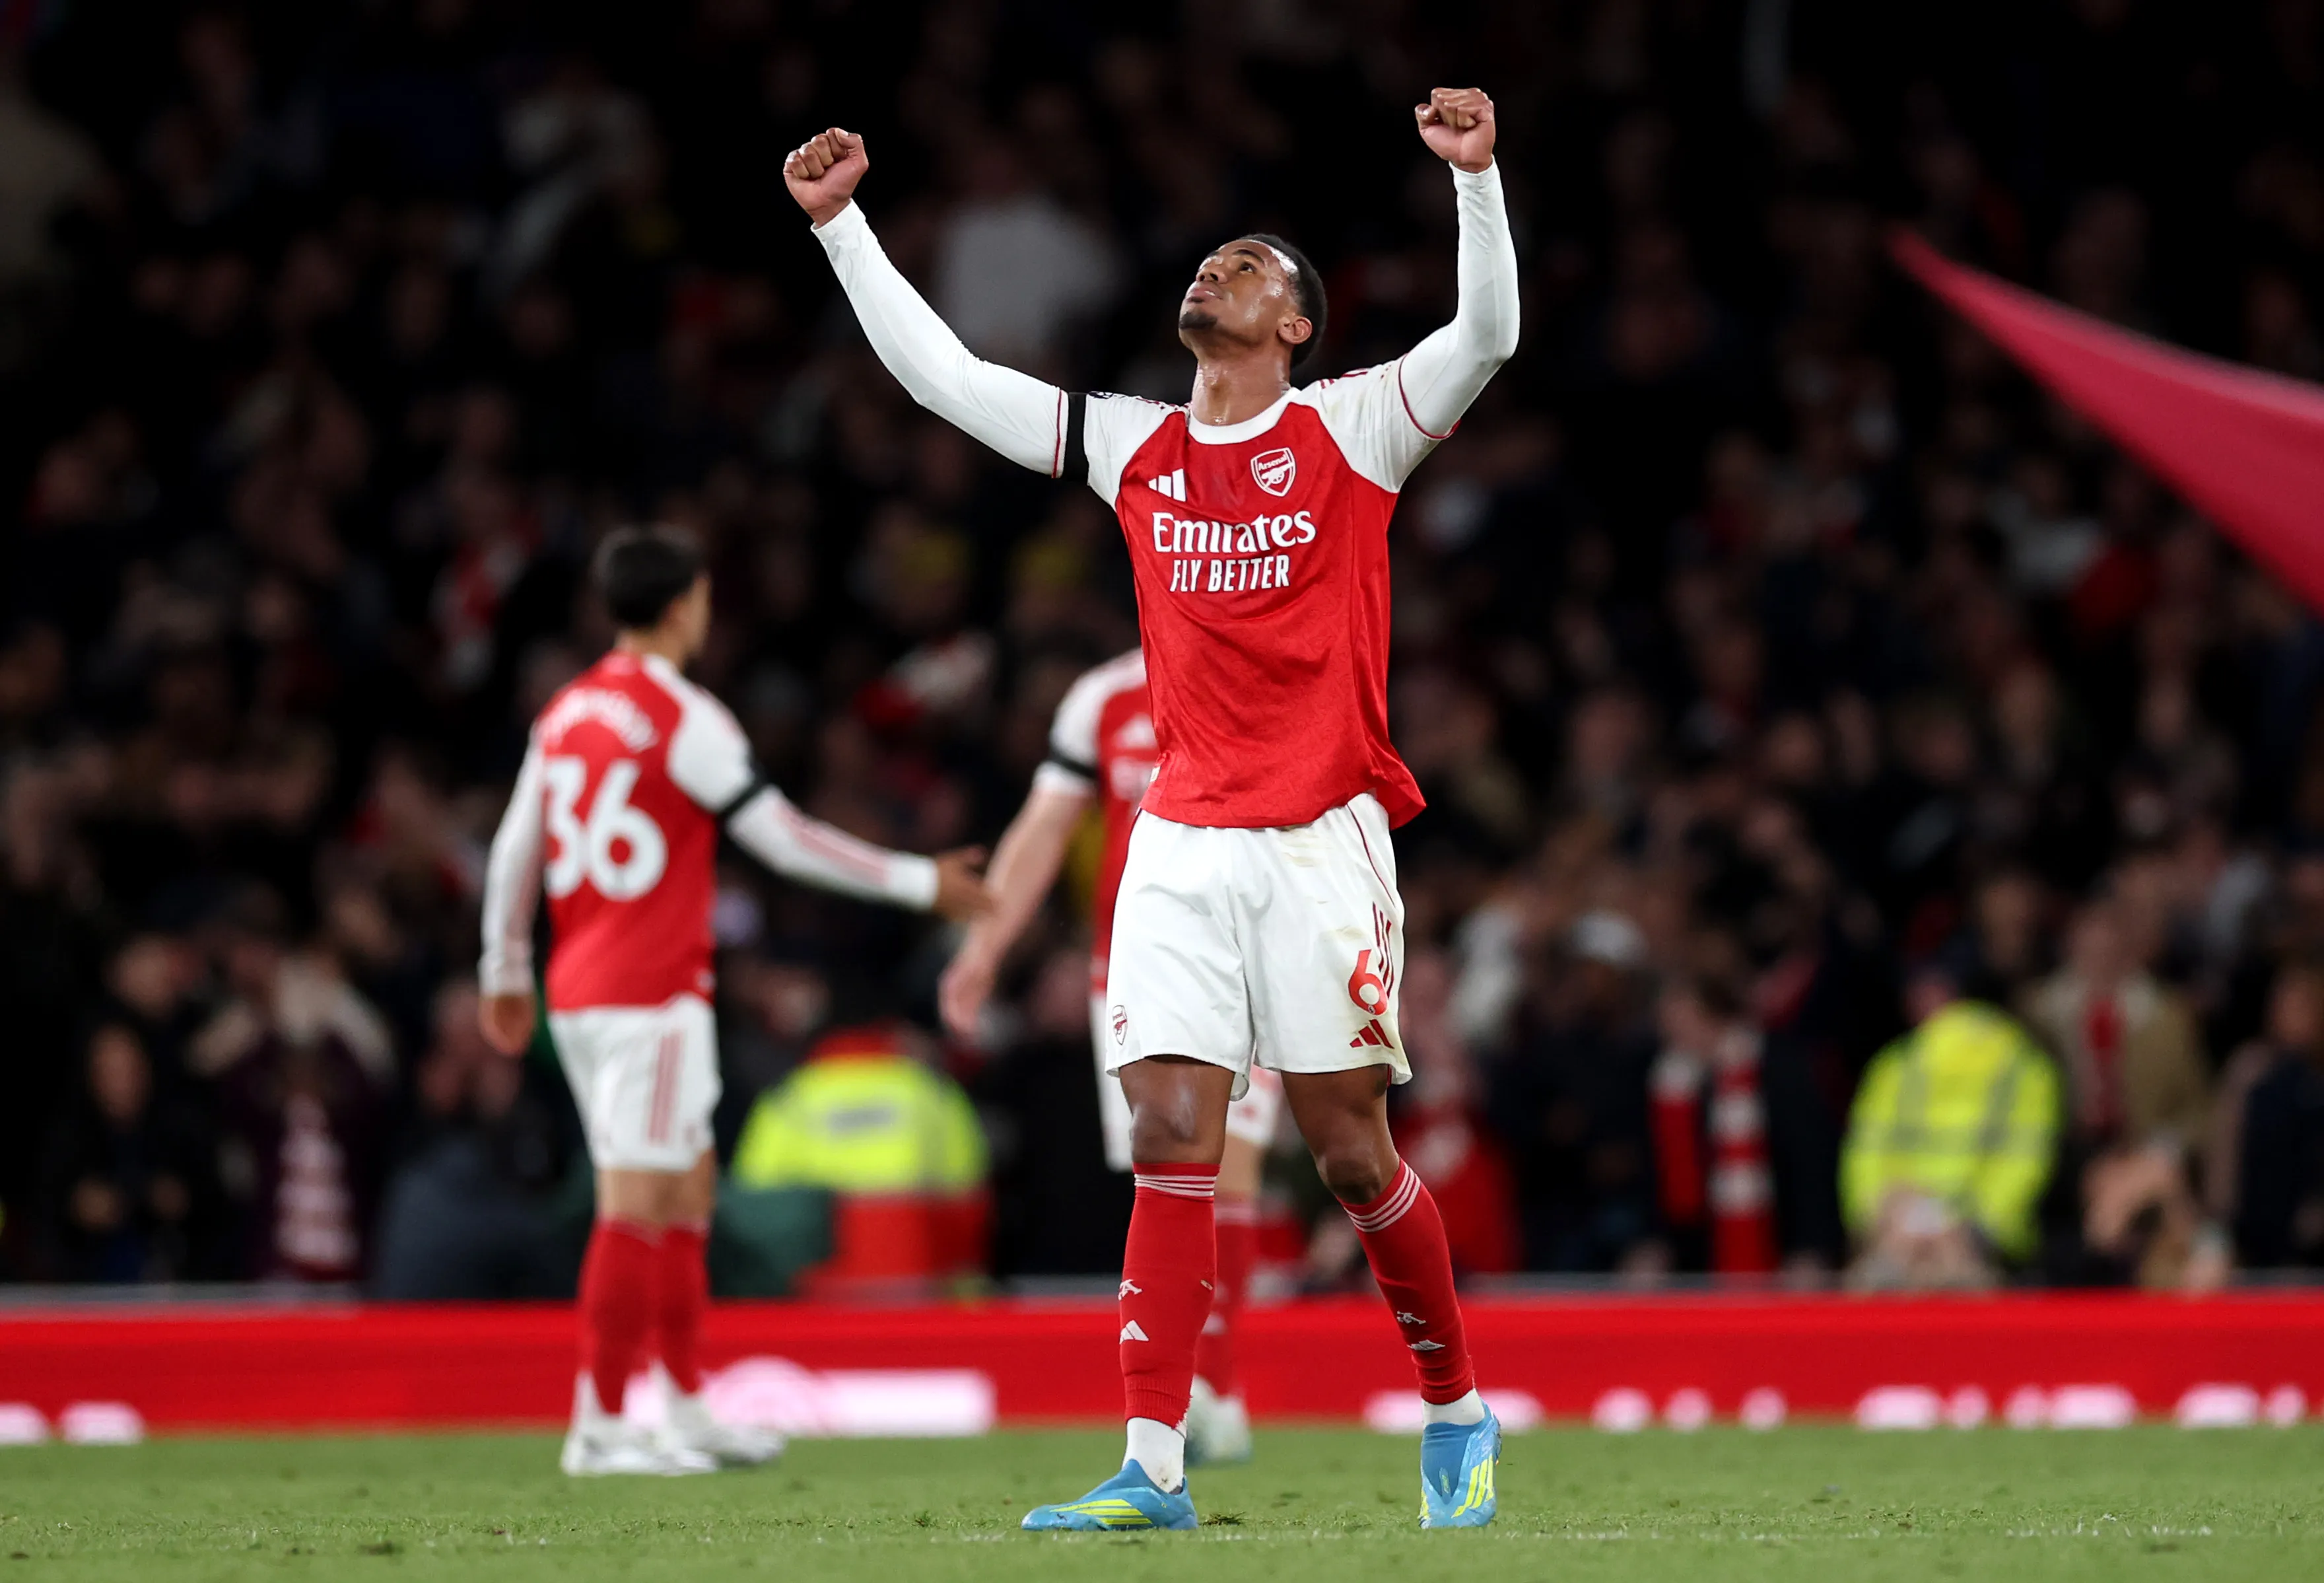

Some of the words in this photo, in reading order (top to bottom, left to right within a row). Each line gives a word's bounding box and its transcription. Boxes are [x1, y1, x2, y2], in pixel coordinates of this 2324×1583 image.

[1257, 454, 1288, 471] Arsenal
[1152, 510, 1316, 553] Emirates
[1170, 559, 1202, 592] FLY
[1208, 555, 1289, 592] BETTER
[546, 757, 667, 901] 36
[1348, 949, 1388, 1015] 6
